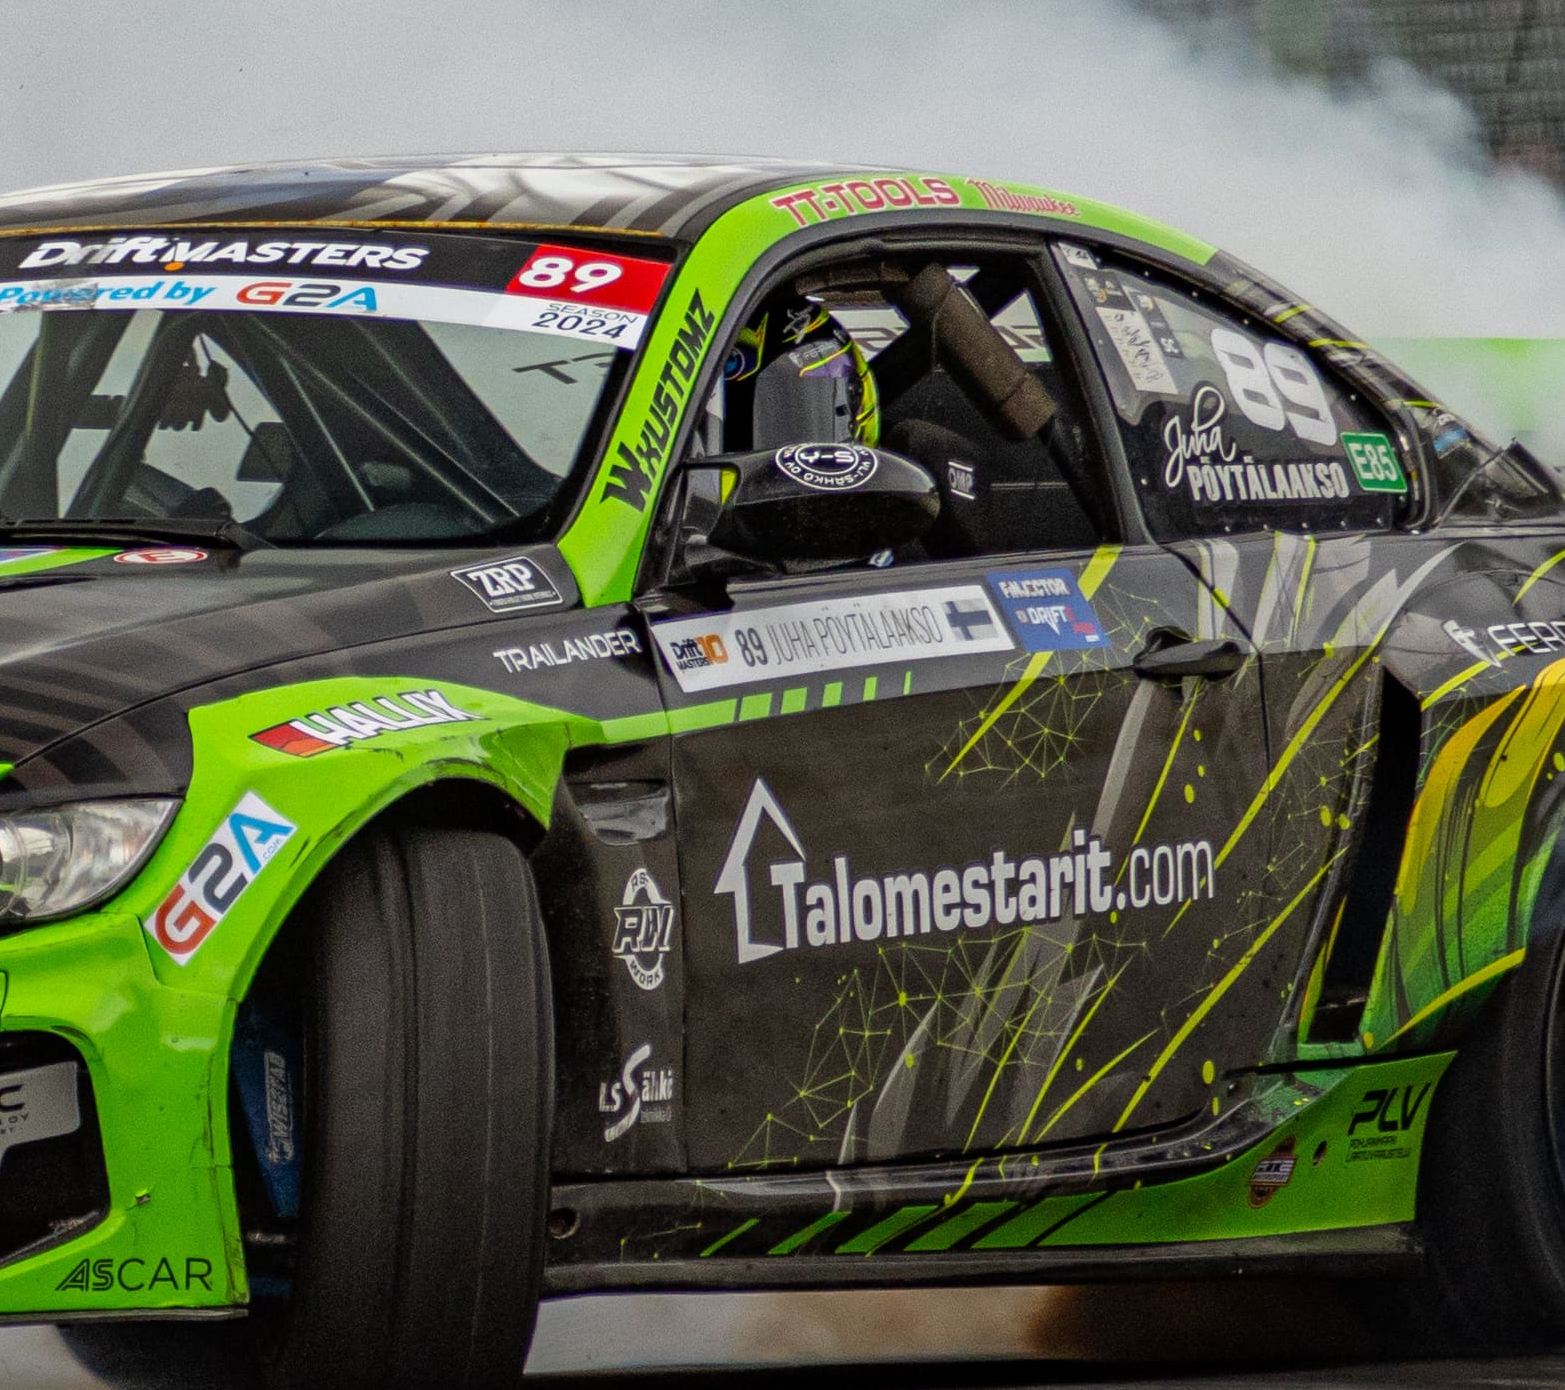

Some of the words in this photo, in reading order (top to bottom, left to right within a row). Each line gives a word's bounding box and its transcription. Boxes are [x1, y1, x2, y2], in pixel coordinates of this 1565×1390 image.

[166, 280, 216, 305] by
[235, 281, 378, 311] G2A
[519, 257, 623, 293] 89
[531, 311, 629, 340] 2024
[548, 302, 639, 325] SEASON
[1211, 328, 1338, 446] 89
[1163, 385, 1236, 487] Juha
[1348, 442, 1399, 482] E85
[467, 563, 536, 598] ZRP
[492, 630, 642, 673] TRAILANDER
[734, 627, 768, 668] 89
[767, 620, 818, 665] JUHA
[289, 689, 492, 746] HALLIX
[155, 812, 294, 955] G2A
[770, 828, 1216, 950] Talomestarit.com
[1348, 1081, 1432, 1136] PLV
[54, 1257, 213, 1292] ASCAR
